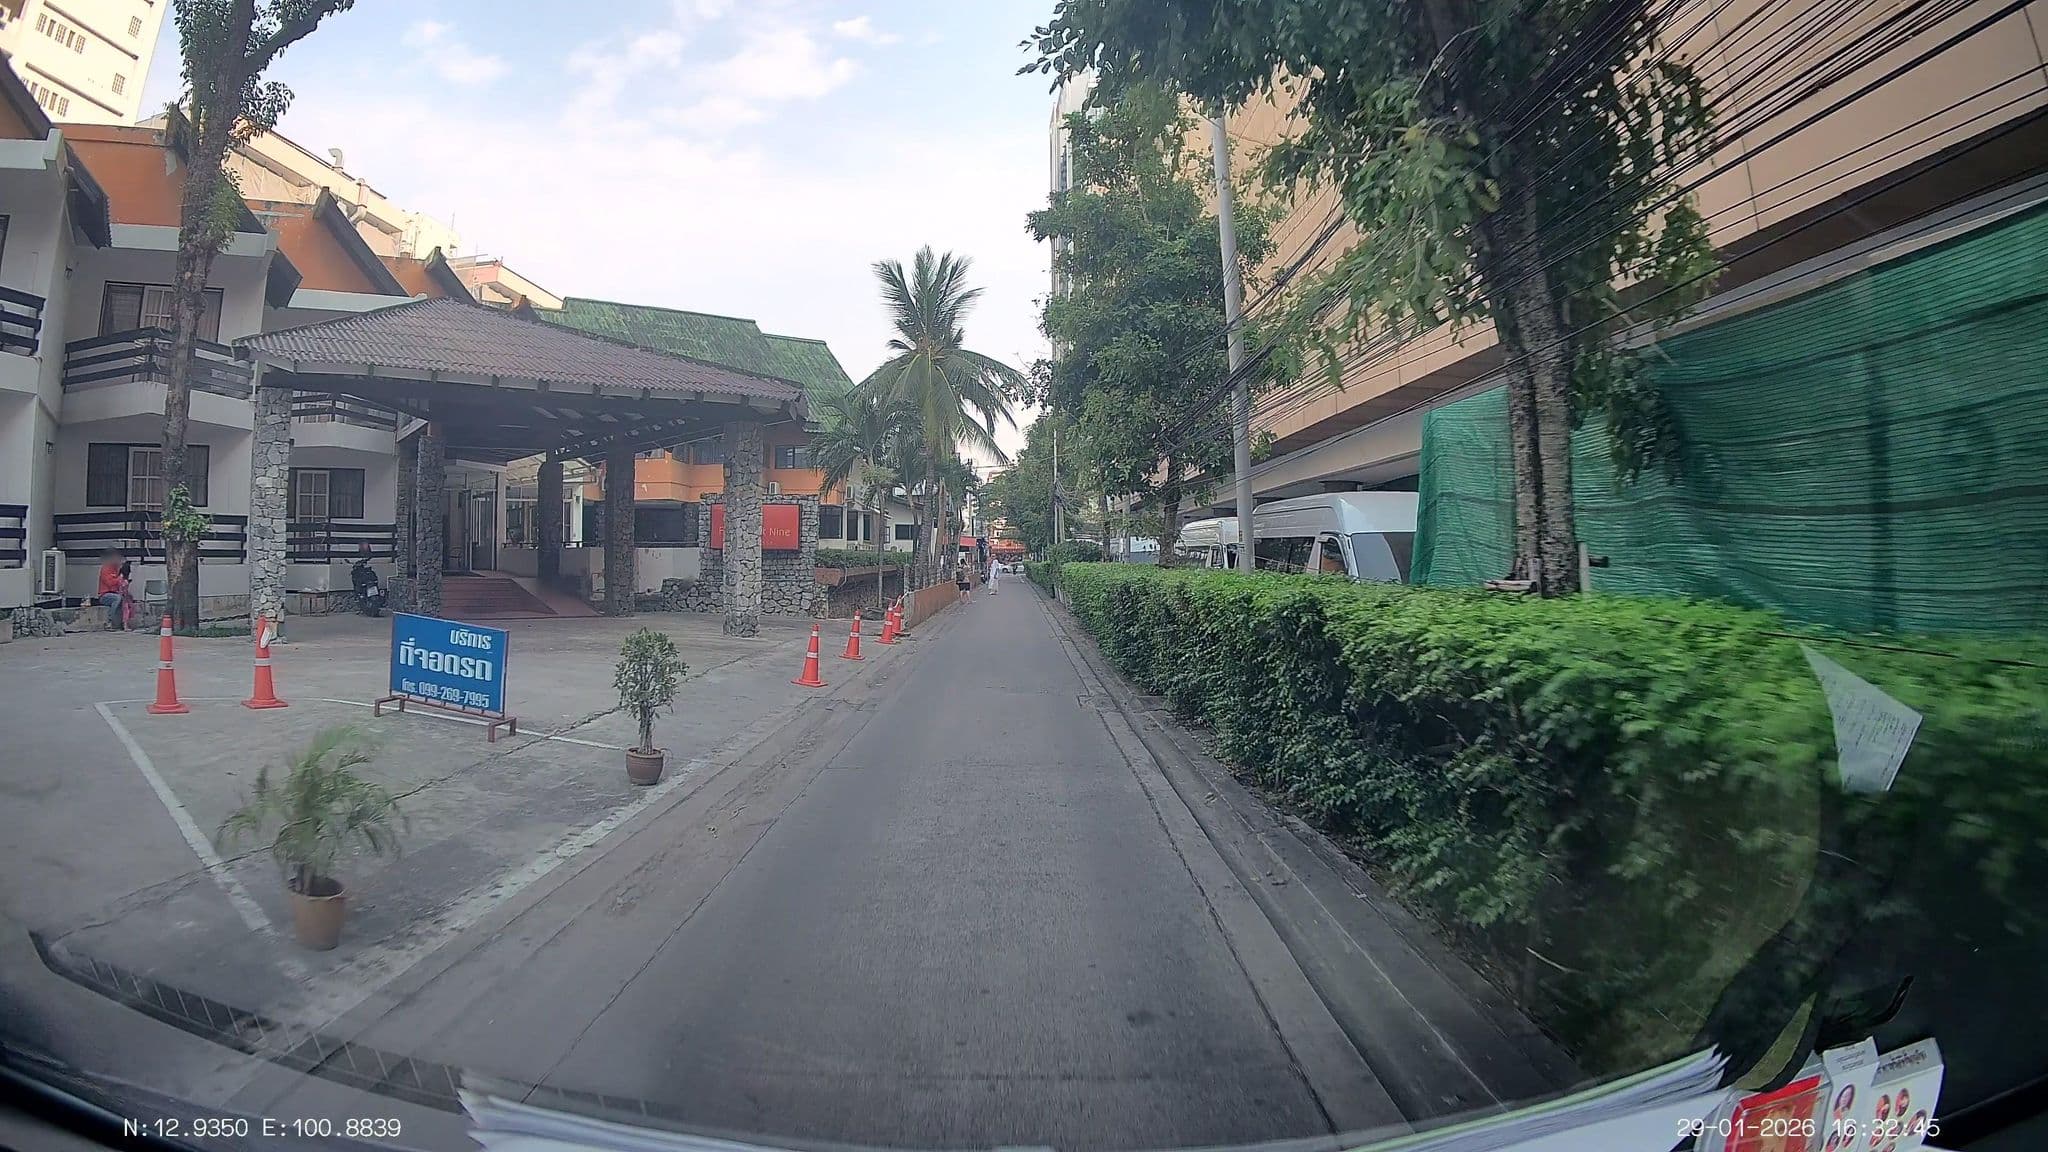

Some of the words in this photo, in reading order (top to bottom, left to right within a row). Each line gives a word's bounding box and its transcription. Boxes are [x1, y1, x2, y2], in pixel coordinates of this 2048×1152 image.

[769, 527, 791, 537] Nine
[450, 628, 493, 650] บริการ
[399, 637, 493, 682] ที่จอดรถ
[401, 677, 418, 694] โทร.
[418, 681, 490, 708] 099-269-7995
